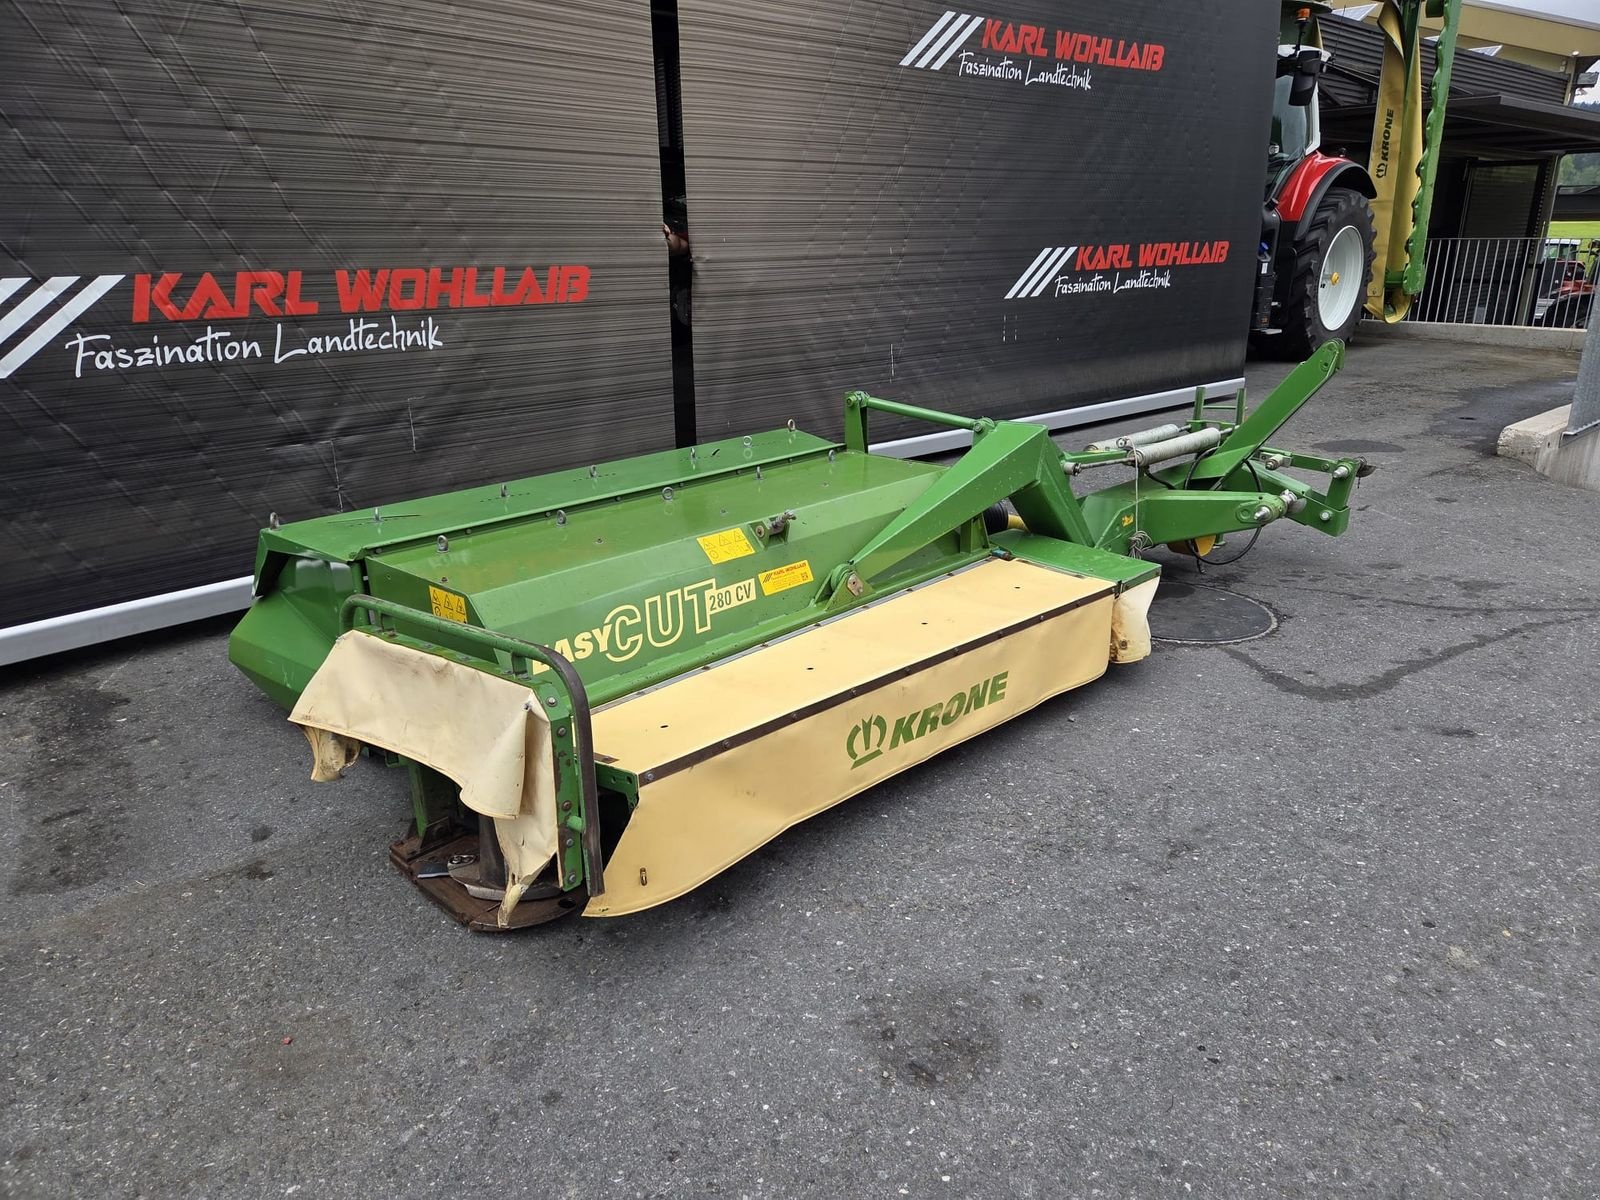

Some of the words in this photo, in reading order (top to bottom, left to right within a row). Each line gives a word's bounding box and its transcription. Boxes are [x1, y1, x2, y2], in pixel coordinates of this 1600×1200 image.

[982, 18, 1048, 57] KARL
[958, 50, 1022, 80] Faszination
[1025, 59, 1092, 90] Landtechnik
[1381, 108, 1394, 162] KRONE
[1075, 244, 1133, 271] KARL
[132, 271, 319, 323] KARL
[1054, 272, 1111, 298] Faszination
[1113, 269, 1171, 294] Landtechnik
[64, 325, 262, 378] Faszination
[274, 314, 443, 364] Landtechnik
[709, 591, 732, 610] 280
[735, 582, 752, 602] CV
[889, 671, 1009, 750] KRONE
